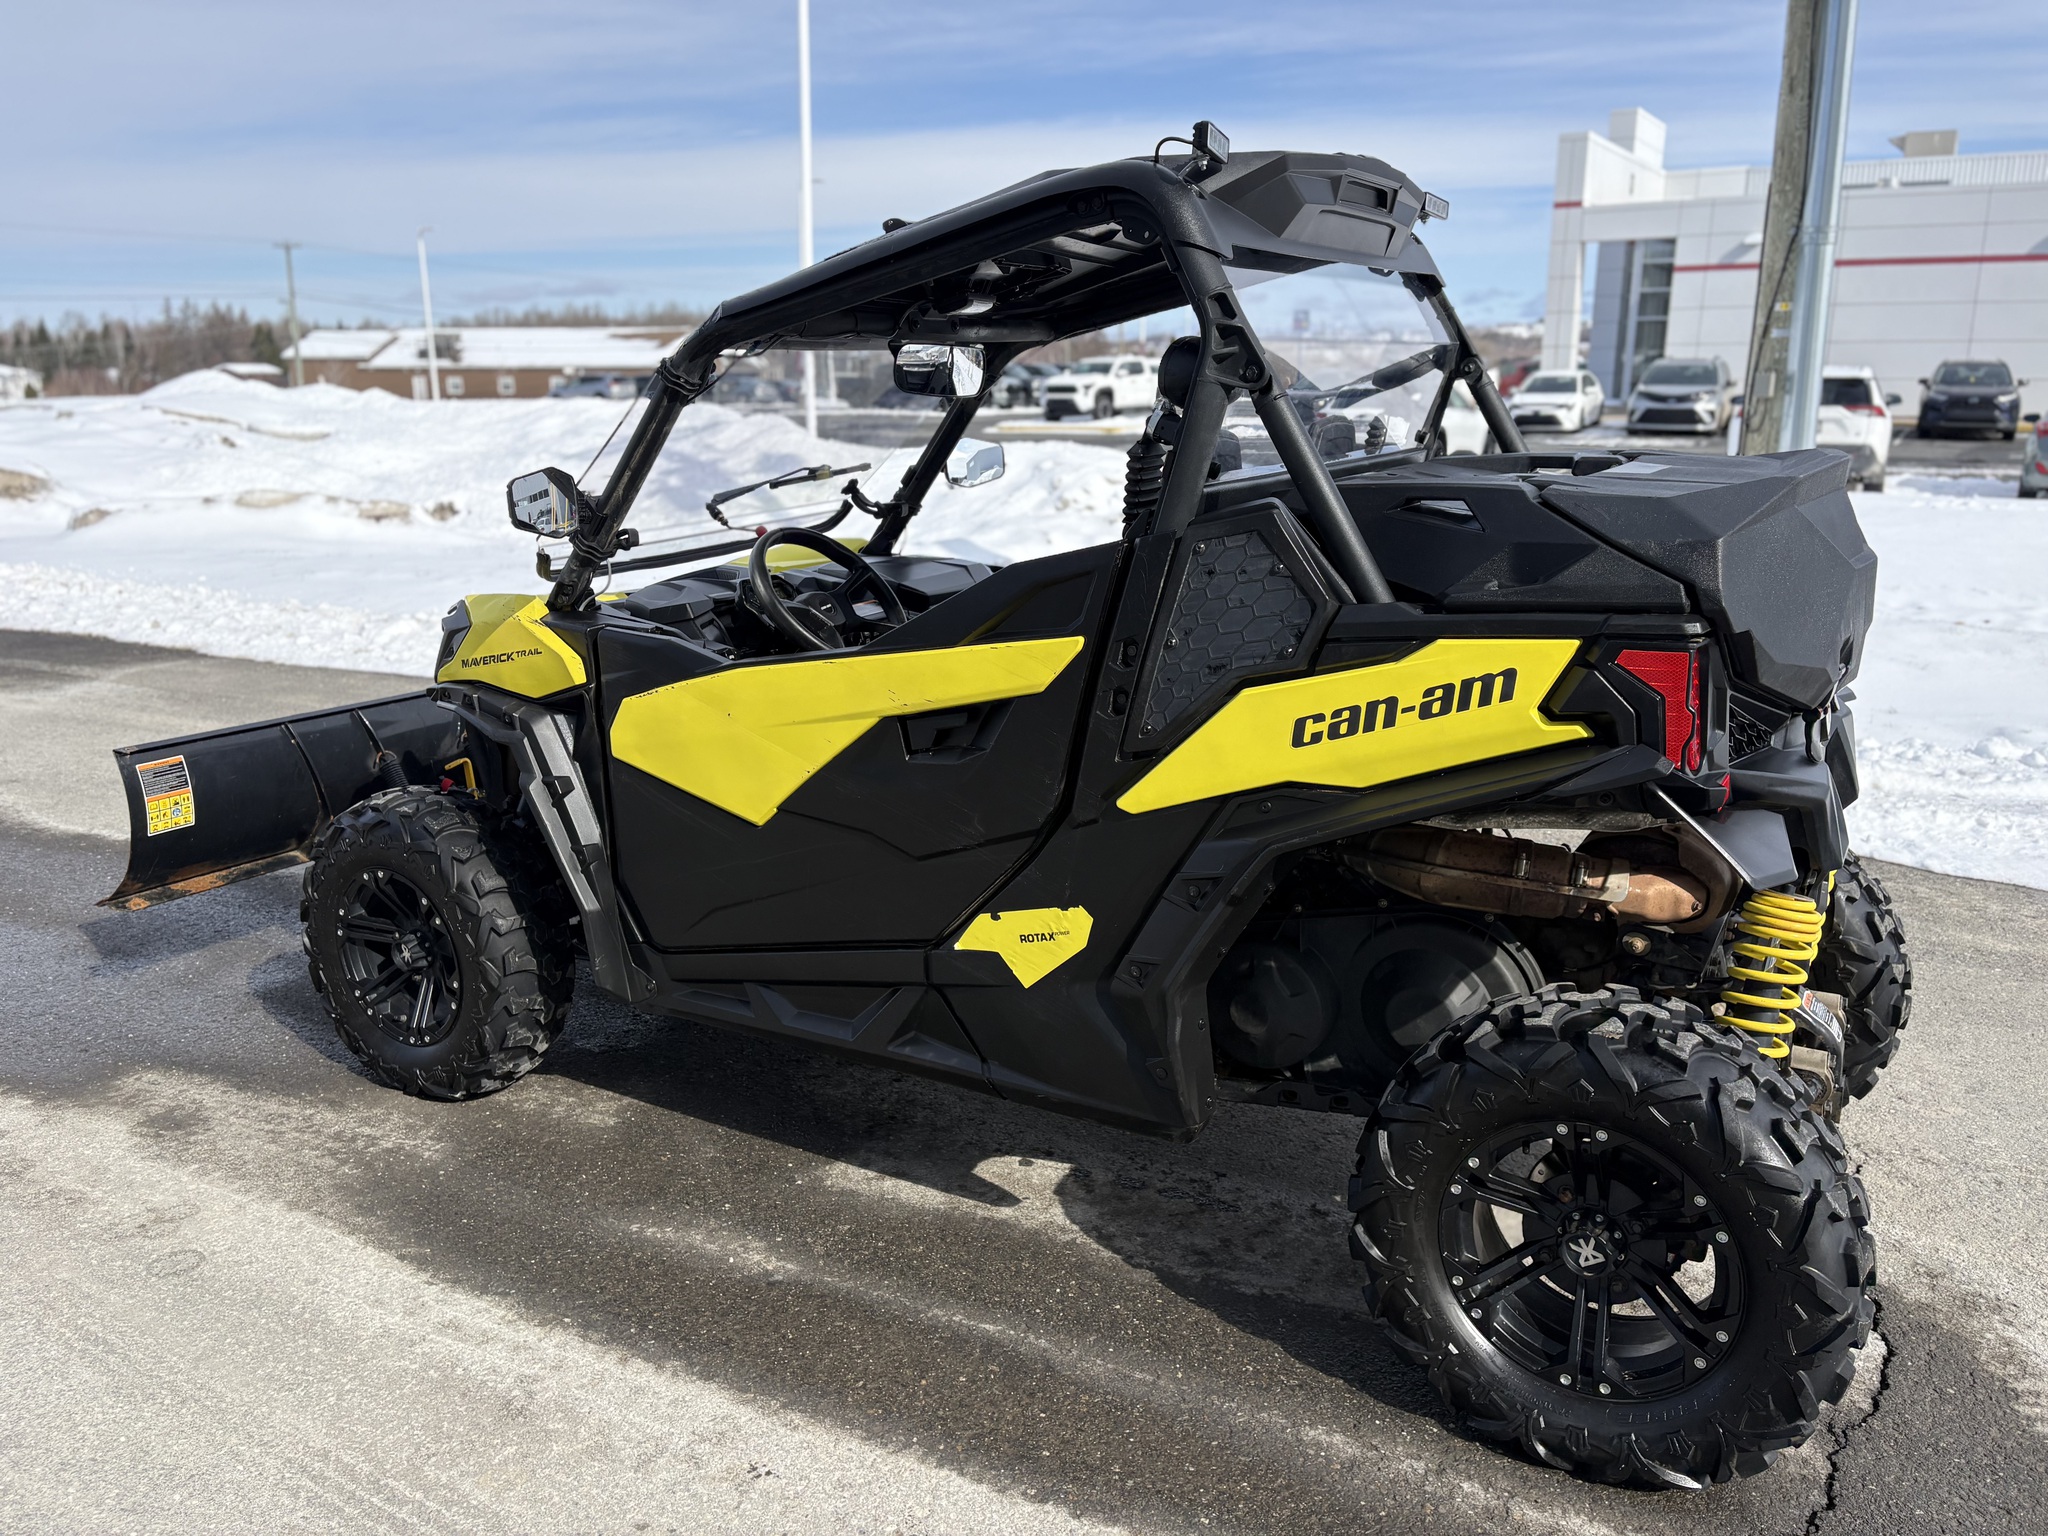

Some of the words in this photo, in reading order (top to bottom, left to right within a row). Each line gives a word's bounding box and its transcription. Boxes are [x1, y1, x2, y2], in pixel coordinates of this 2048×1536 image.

[461, 652, 515, 668] MAVERICK
[515, 648, 542, 658] TRAIL
[1291, 667, 1518, 749] can-am
[1019, 932, 1056, 944] ROTAX
